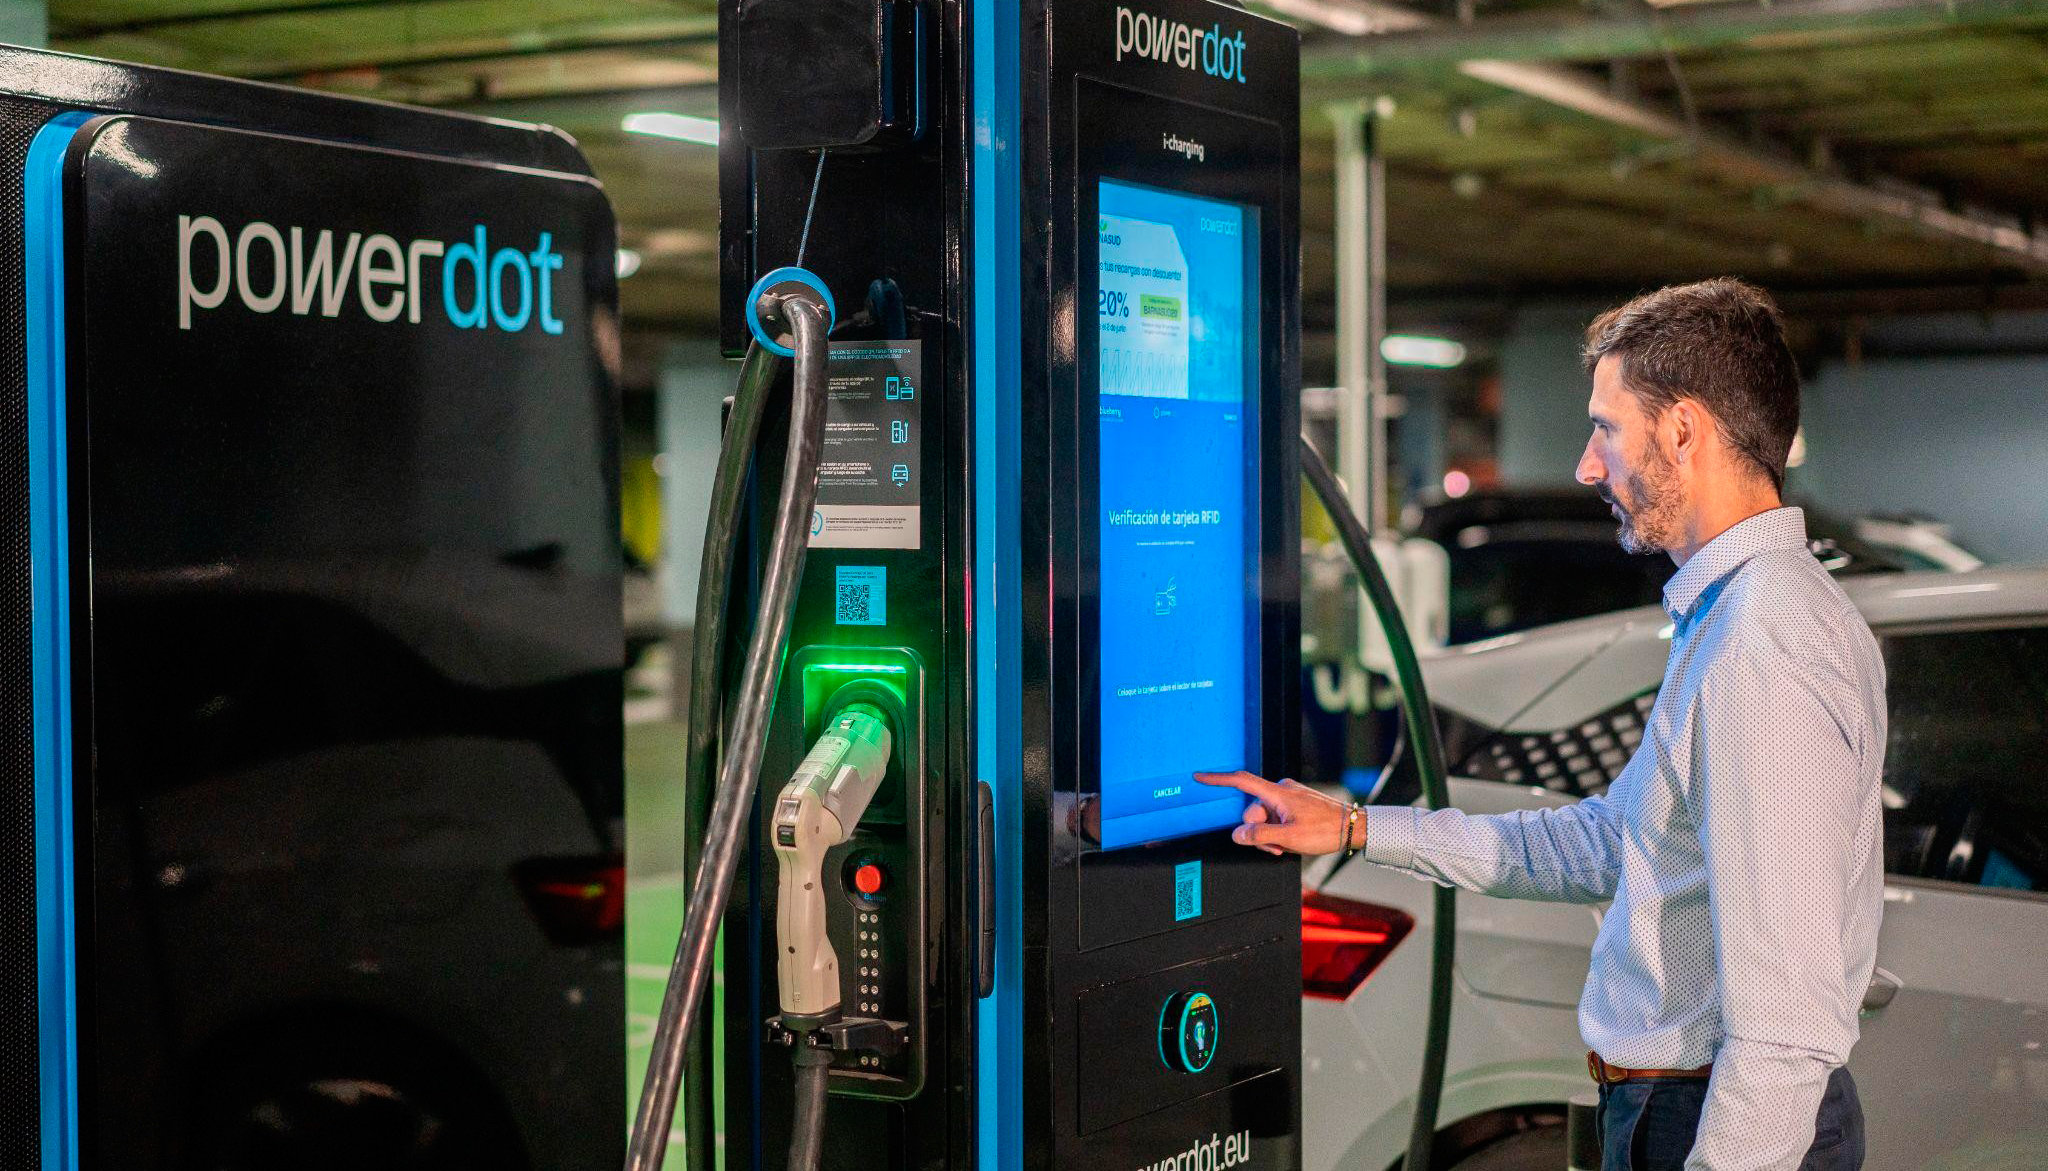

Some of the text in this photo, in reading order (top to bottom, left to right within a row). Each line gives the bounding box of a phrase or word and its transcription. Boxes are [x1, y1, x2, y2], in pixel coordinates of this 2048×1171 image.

[1116, 6, 1246, 83] powerdot
[178, 214, 564, 335] powerdot
[1114, 264, 1141, 277] recargas
[1108, 509, 1220, 528] Verificación de tarjeta RFID
[1137, 1129, 1250, 1171] rdot.eu
